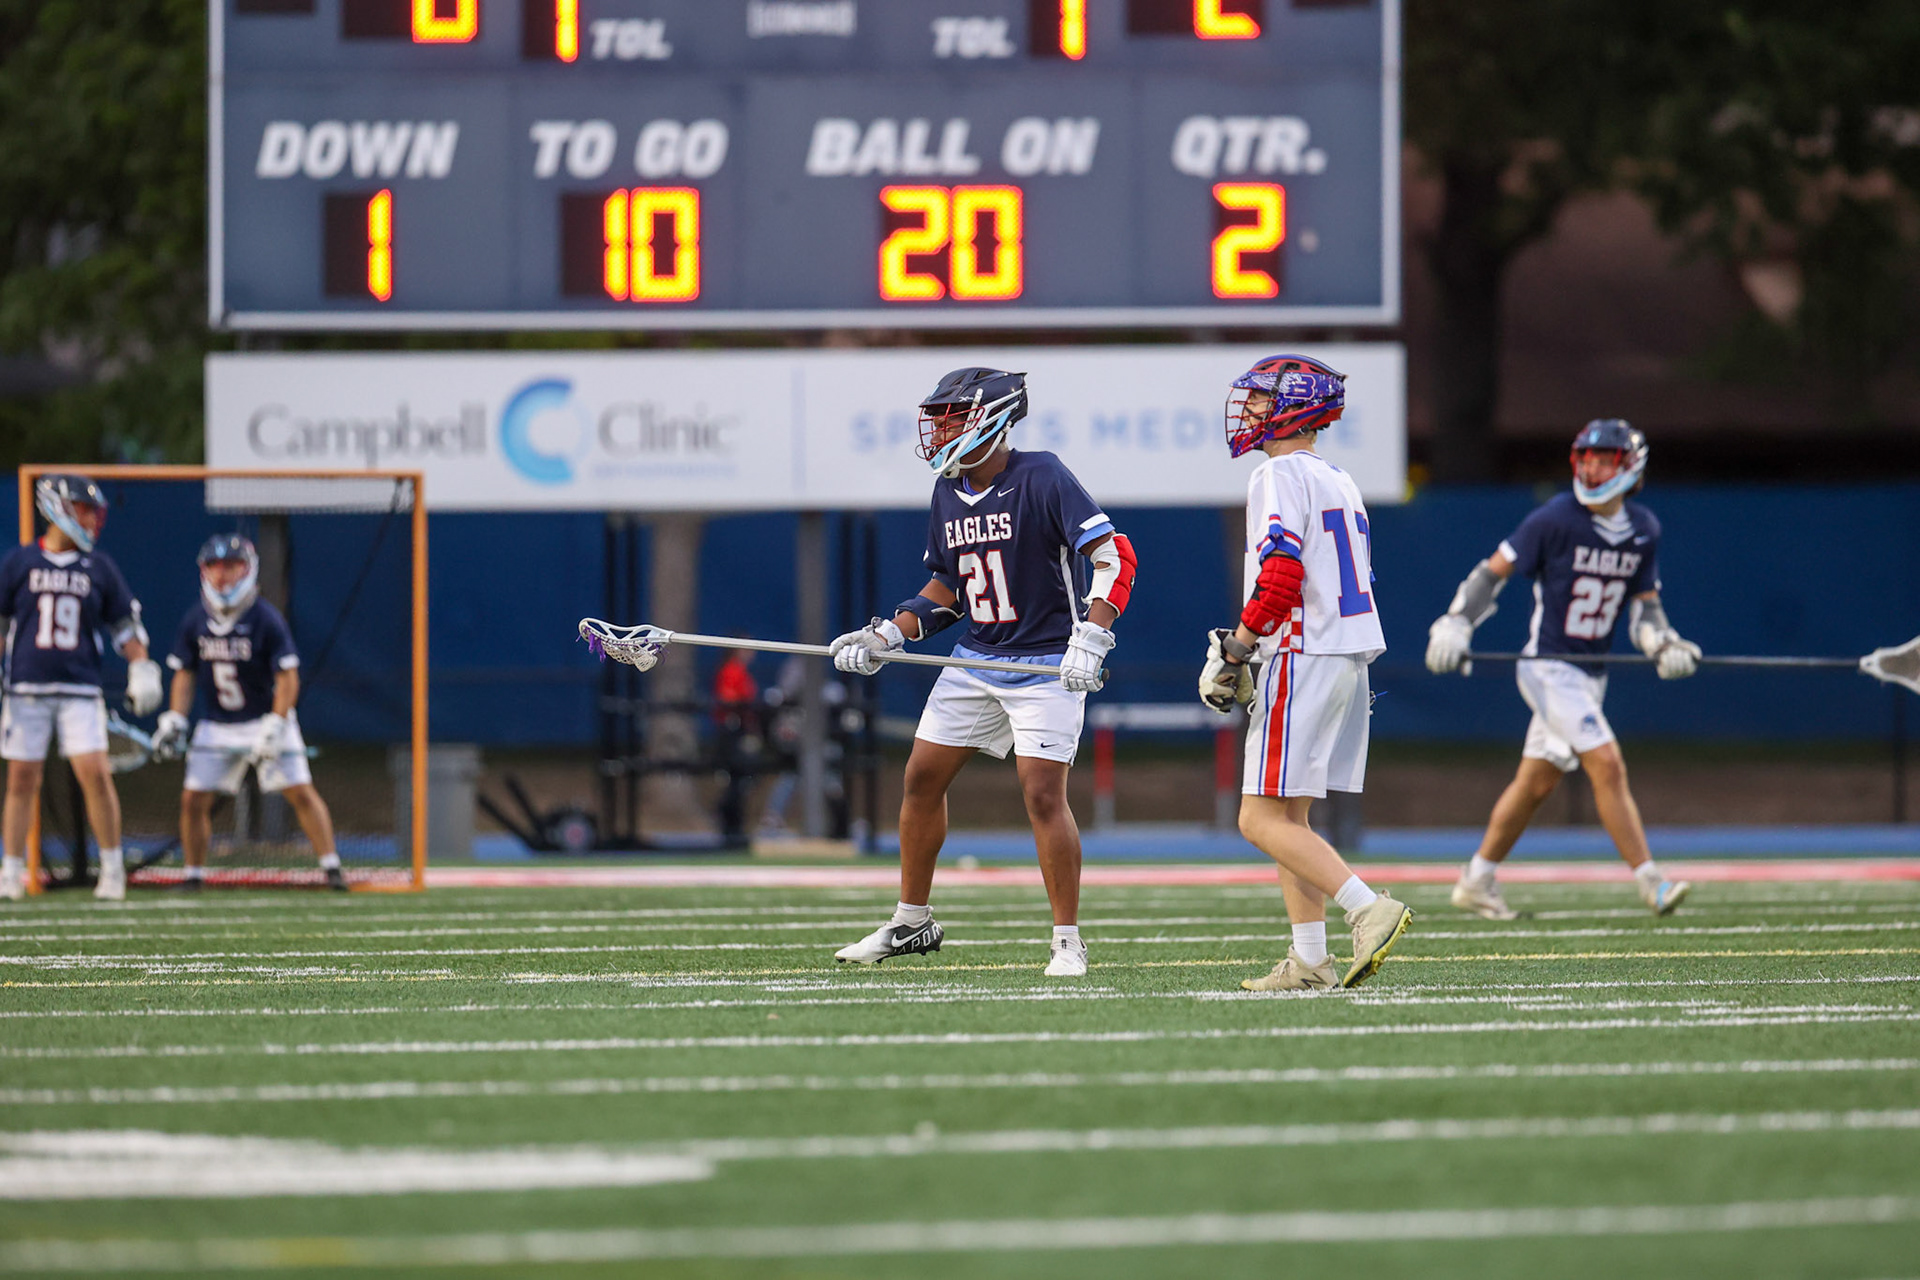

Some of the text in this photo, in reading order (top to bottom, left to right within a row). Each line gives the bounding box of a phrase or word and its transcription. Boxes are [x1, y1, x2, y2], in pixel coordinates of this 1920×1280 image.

[590, 19, 671, 60] TOL
[932, 18, 1016, 58] TOL
[256, 121, 460, 179] DOWN
[529, 119, 728, 178] TO GO
[806, 117, 1100, 176] BALL ON
[1172, 116, 1327, 178] QTR.
[368, 189, 392, 301] 1
[604, 187, 699, 302] 10
[880, 185, 1023, 300] 20
[1212, 183, 1285, 298] 2
[247, 399, 488, 470] Campbell
[599, 400, 736, 458] Clinic
[945, 511, 1012, 549] EAGLES
[28, 567, 91, 597] EAGLES
[958, 550, 1018, 624] 21
[1564, 575, 1627, 640] 23
[35, 593, 81, 650] 19
[212, 661, 247, 711] 5
